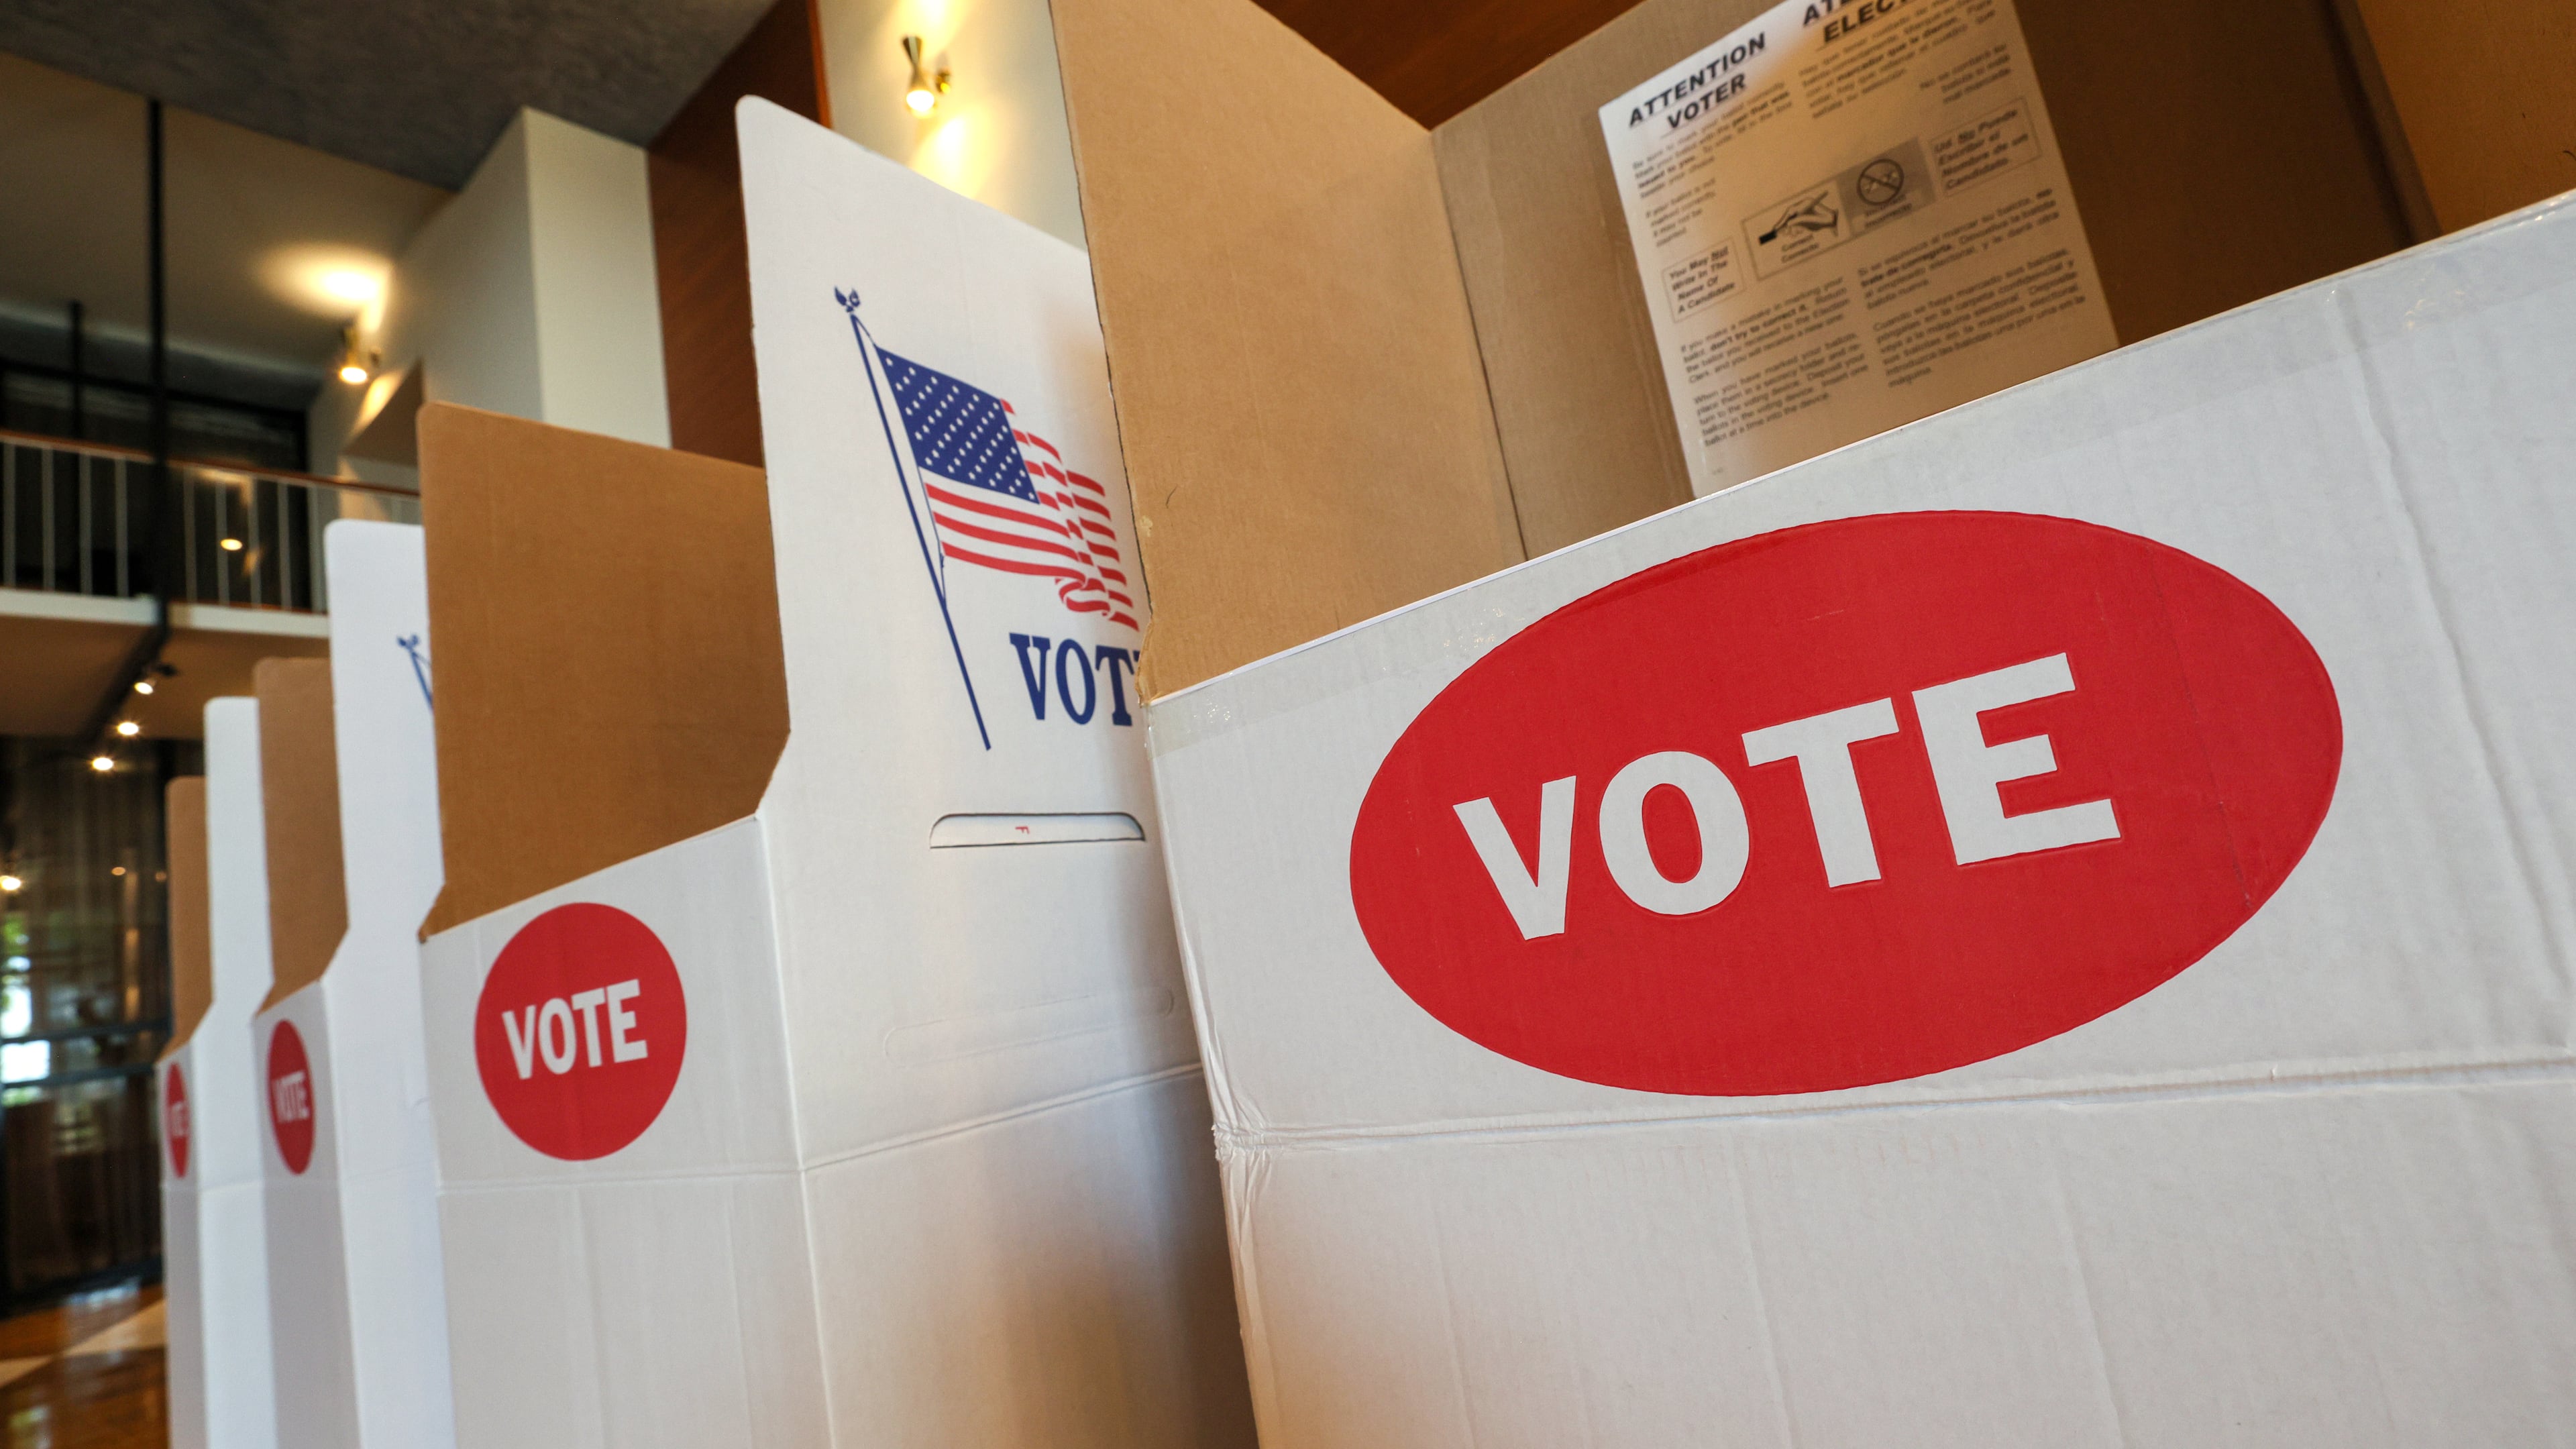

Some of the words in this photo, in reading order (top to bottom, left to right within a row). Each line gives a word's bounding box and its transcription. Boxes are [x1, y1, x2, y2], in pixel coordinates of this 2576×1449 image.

[1804, 0, 1851, 25] AT
[1823, 0, 1907, 42] ELEC
[1629, 32, 1766, 125] ATTENTION
[1668, 74, 1746, 129] VOTER
[1670, 267, 1686, 280] You
[1690, 257, 1708, 270] May
[1711, 247, 1729, 261] Not
[1672, 275, 1697, 291] Write
[1699, 270, 1707, 278] In
[1711, 260, 1728, 272] The
[1677, 305, 1685, 313] A
[1688, 282, 1735, 308] Candidate
[1678, 284, 1704, 301] Name
[1707, 277, 1719, 286] Of
[1009, 632, 1140, 727] VOT
[1452, 651, 2121, 941] VOTE
[502, 979, 648, 1080] VOTE
